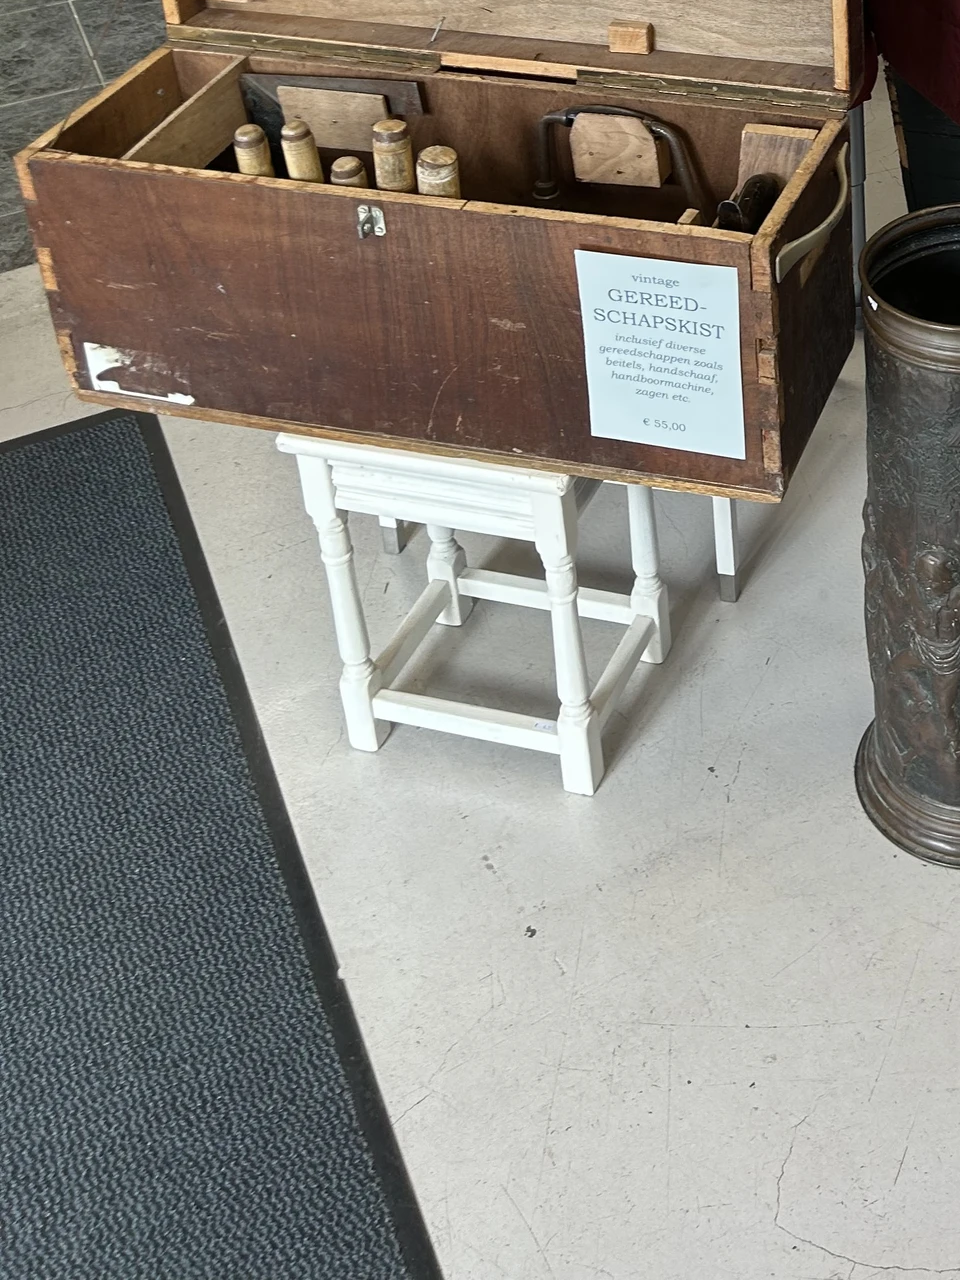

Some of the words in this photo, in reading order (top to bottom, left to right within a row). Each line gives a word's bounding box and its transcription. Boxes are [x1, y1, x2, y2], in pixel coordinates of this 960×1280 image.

[632, 274, 680, 288] vintage
[607, 288, 707, 312] GEREED-
[593, 308, 725, 340] SCHAPSKIST
[615, 333, 664, 349] inclusief
[665, 340, 706, 355] diverse
[599, 345, 691, 364] gereedschappen
[694, 359, 723, 371] zoals
[605, 357, 645, 371] beitels,
[649, 363, 718, 384] handschaaf,
[611, 371, 714, 396] handboormachine,
[635, 388, 669, 399] zagen
[672, 394, 691, 403] etc.
[643, 418, 650, 426] €
[654, 419, 686, 432] 55,00
